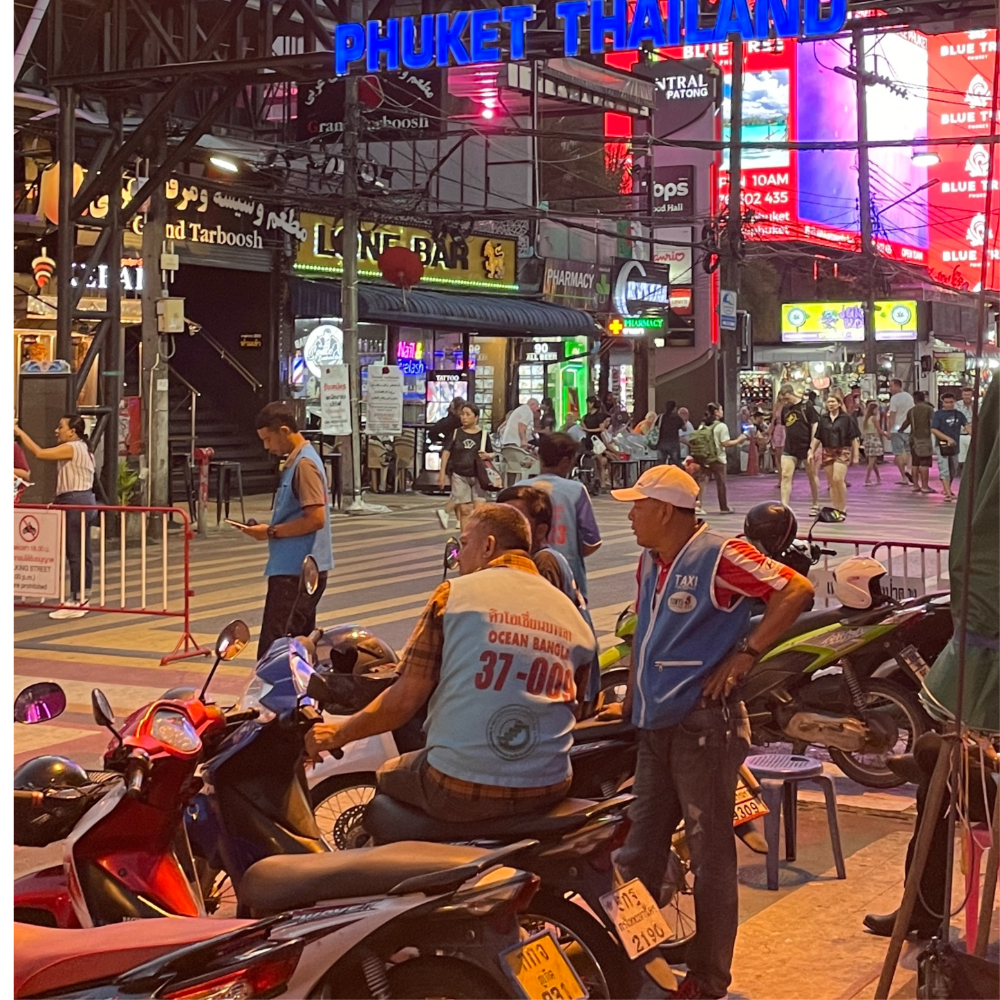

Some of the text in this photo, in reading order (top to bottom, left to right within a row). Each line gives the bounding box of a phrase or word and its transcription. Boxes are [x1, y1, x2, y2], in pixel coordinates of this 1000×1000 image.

[335, 3, 536, 76] PHUKET
[683, 42, 729, 59] BLUE
[940, 43, 975, 57] BLUE
[666, 87, 709, 100] PATONG
[940, 112, 975, 125] BLUE
[752, 173, 789, 187] 10AM
[941, 181, 976, 193] BLUE
[765, 191, 788, 203] 435
[668, 203, 683, 212] Hall
[189, 222, 264, 250] Tarboosh
[409, 232, 469, 271] BAR
[942, 250, 978, 262] BLUE
[546, 268, 595, 289] PHARMACY
[624, 318, 664, 330] PHARMACY
[397, 341, 415, 360] Nail
[534, 342, 549, 354] 90
[435, 374, 460, 382] TATTOO
[30, 565, 51, 573] STREET
[675, 574, 699, 588] TAXI
[487, 630, 529, 648] OCEAN
[631, 922, 665, 953] 2190
